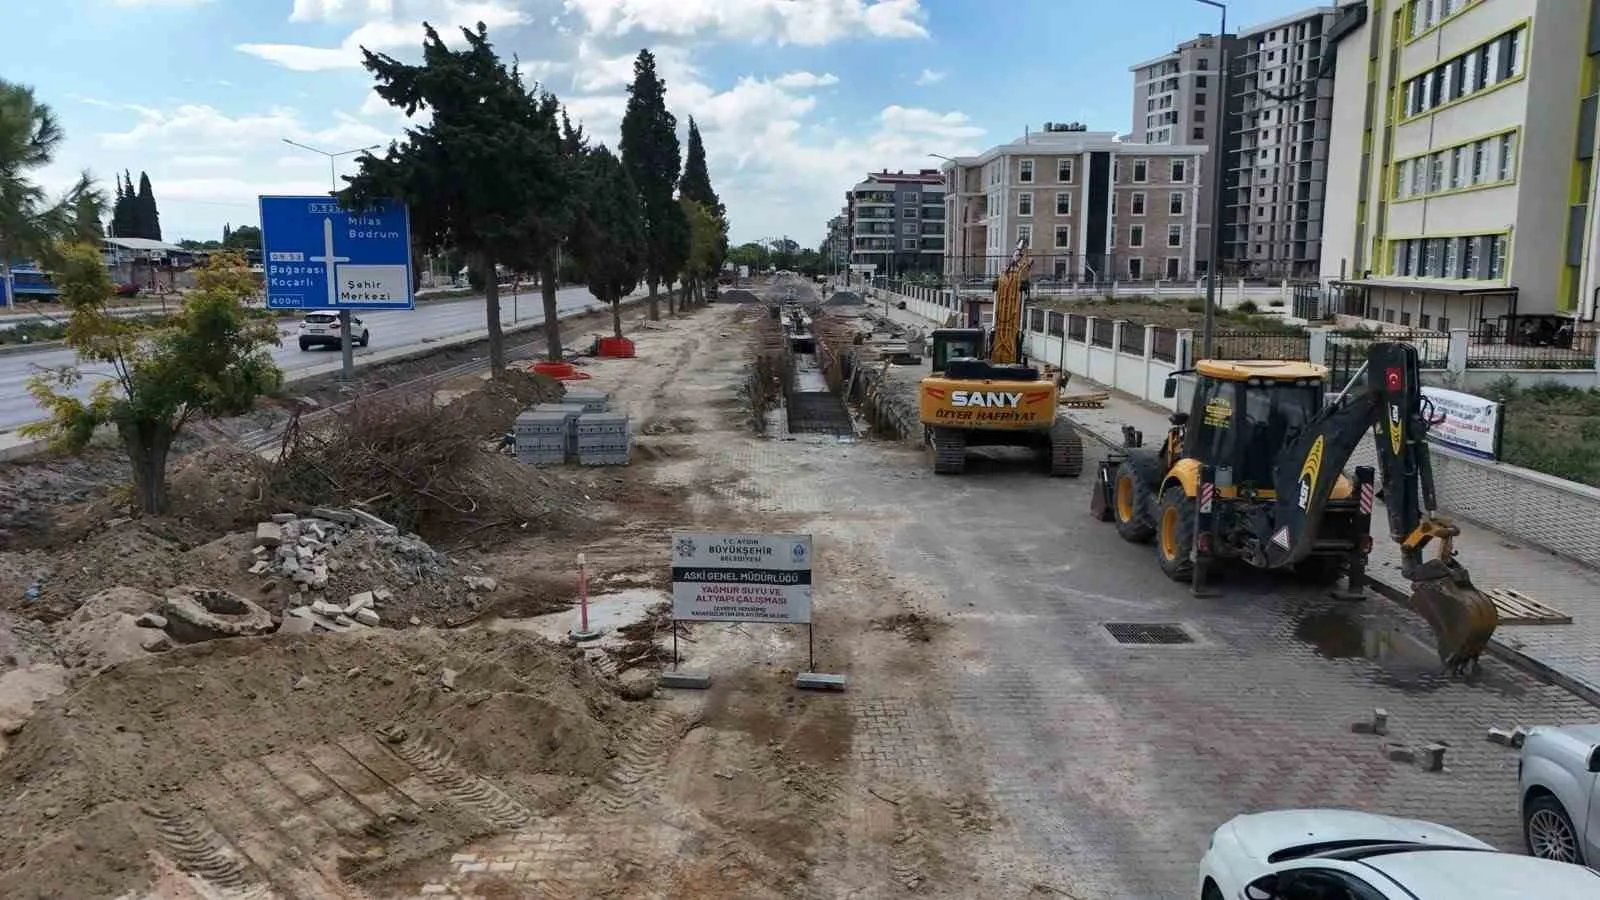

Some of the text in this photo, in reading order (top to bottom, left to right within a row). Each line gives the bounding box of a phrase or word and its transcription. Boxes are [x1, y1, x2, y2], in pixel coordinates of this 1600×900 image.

[348, 216, 381, 226] Milas
[349, 229, 399, 239] Bodrum
[270, 265, 324, 276] Bağarası
[271, 278, 314, 287] Koçarlı
[347, 280, 382, 290] Şehir
[271, 297, 301, 305] 400m
[341, 291, 391, 301] Merkezi
[951, 390, 1023, 408] SANY
[708, 545, 773, 556] BÜYÜKŞEHİR
[683, 570, 799, 583] ASKİ GENEL MÜDÜRLÜĞÜ
[701, 585, 781, 596] YAĞMUR SUYU VE
[695, 595, 787, 605] ALTYAPI ÇALIŞMASI
